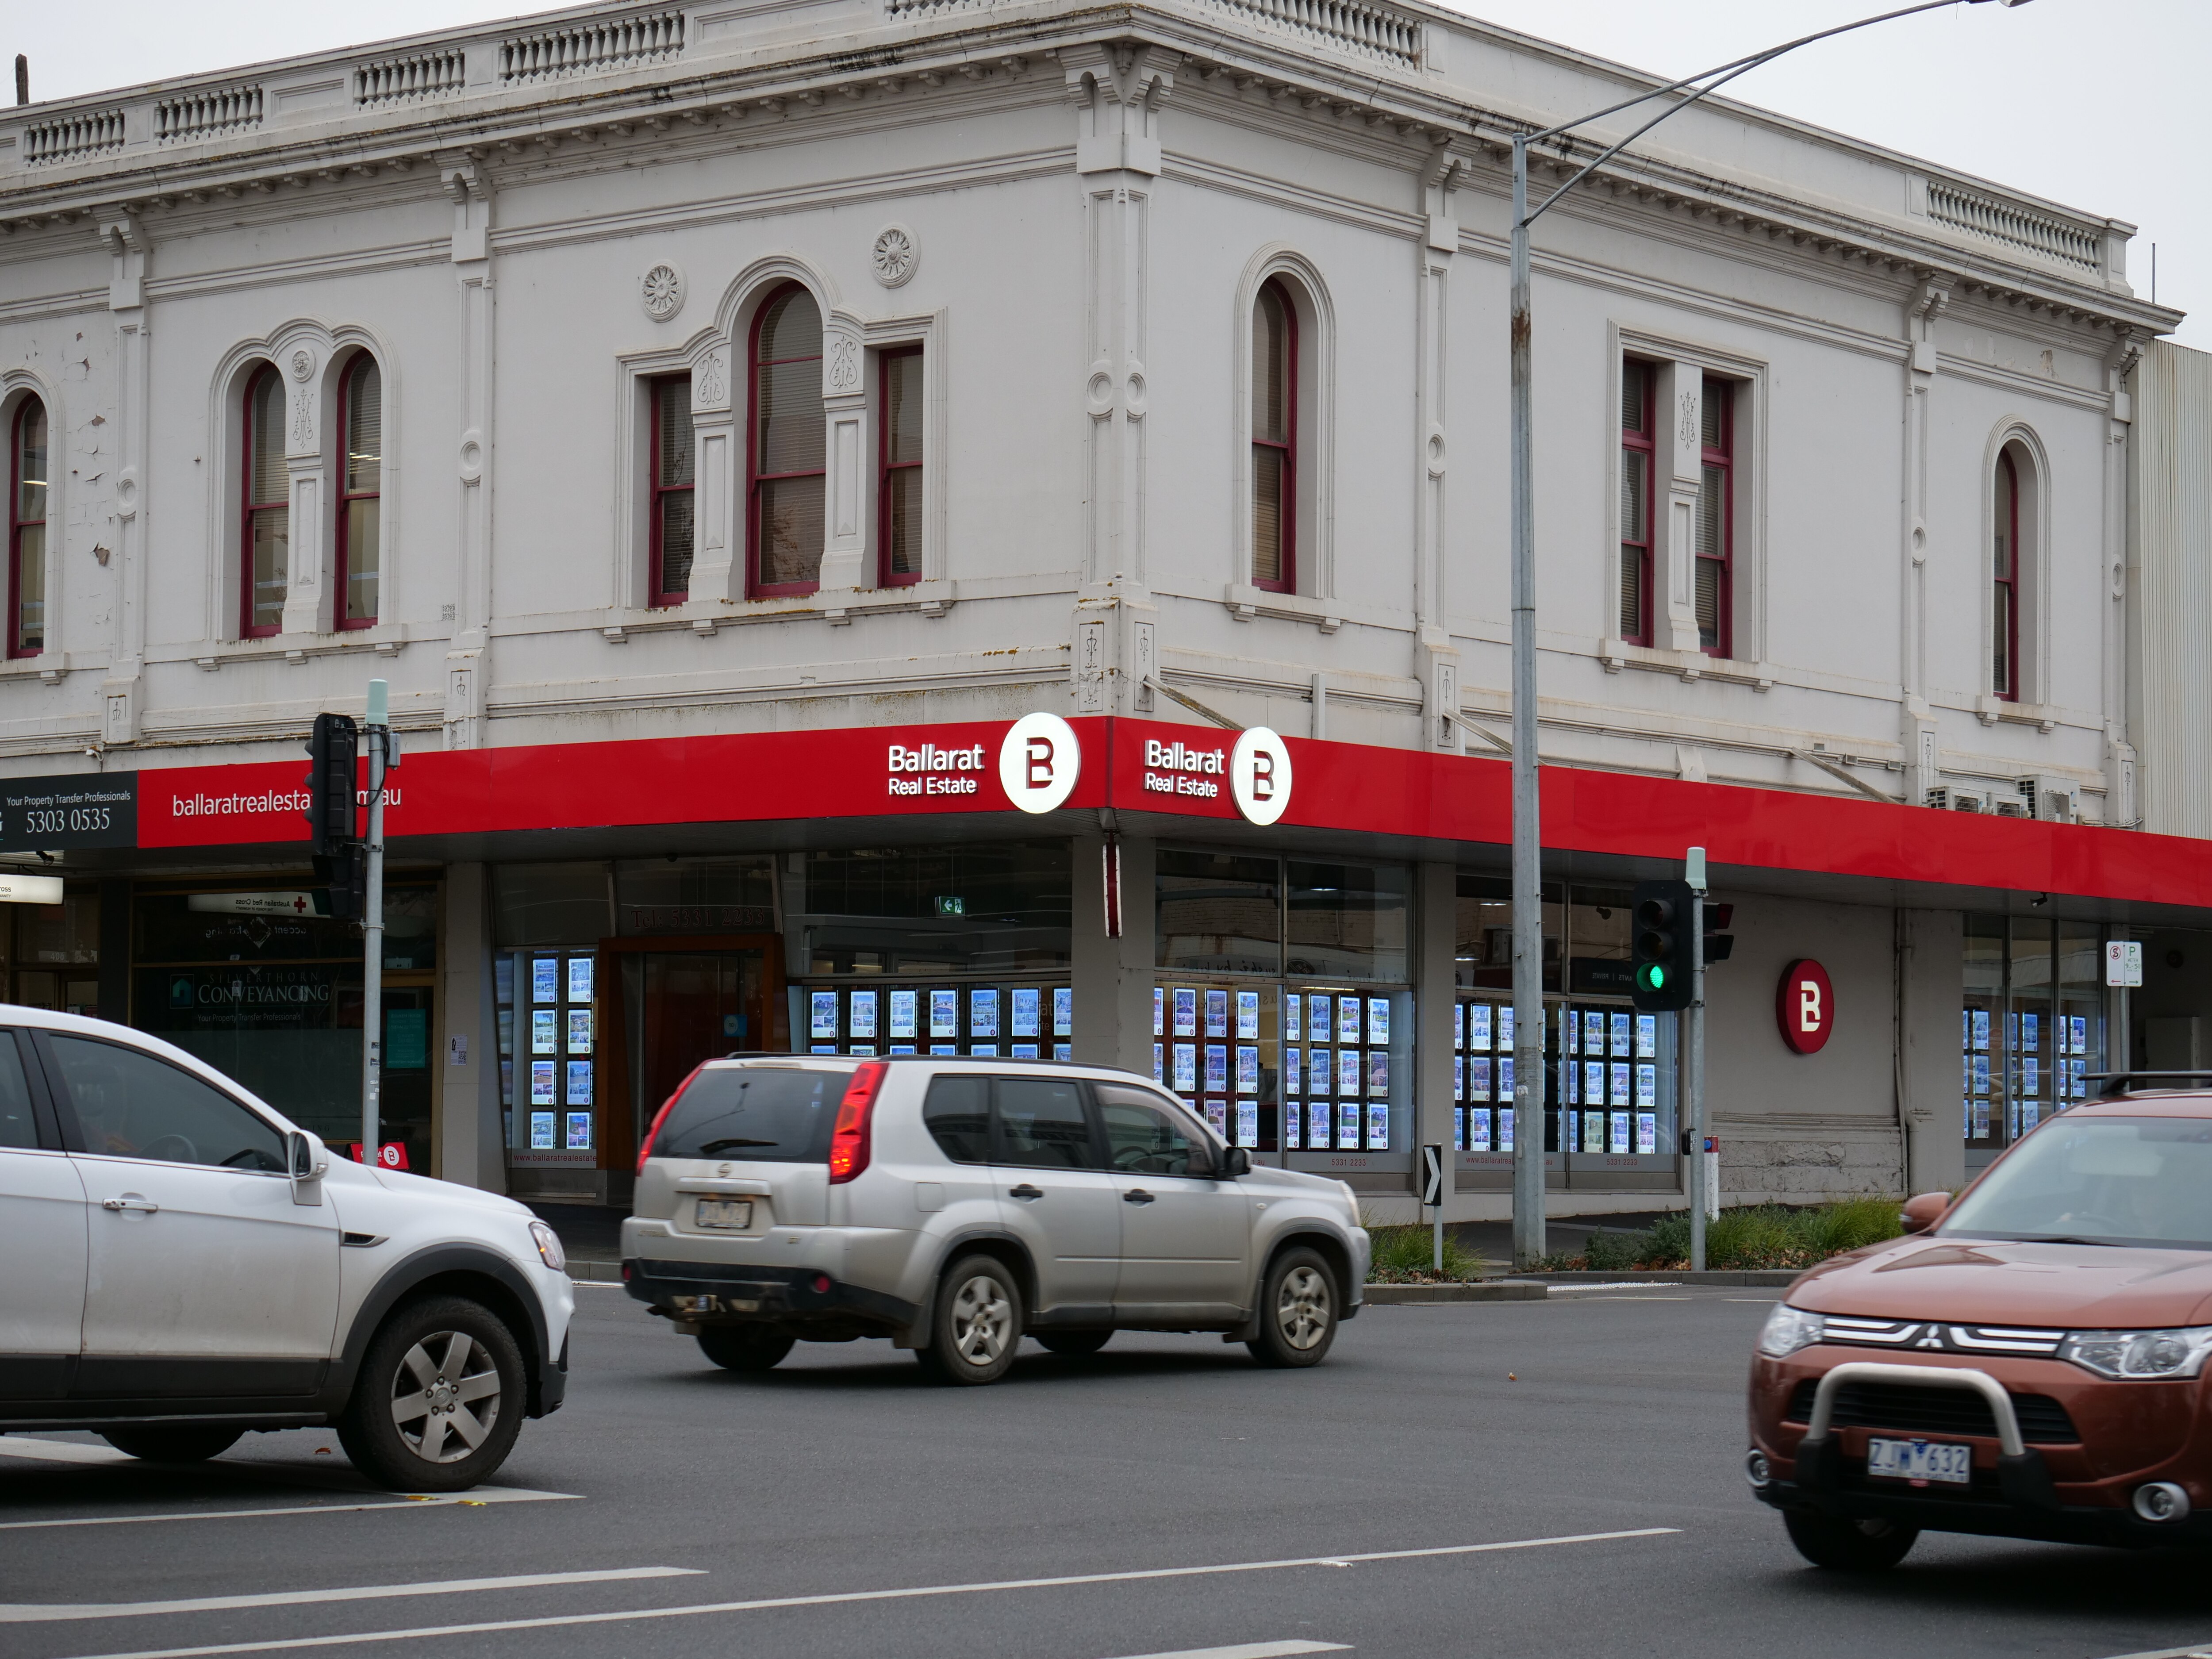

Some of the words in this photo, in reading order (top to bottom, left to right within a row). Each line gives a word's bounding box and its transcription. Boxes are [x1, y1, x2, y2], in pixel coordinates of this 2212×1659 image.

[889, 744, 985, 771] Ballarat
[1026, 737, 1054, 790] B
[1145, 740, 1224, 774] Ballarat
[889, 777, 922, 795] Real
[926, 776, 977, 795] Estate
[1146, 772, 1173, 792] Real
[1178, 776, 1218, 798] Estate
[1253, 750, 1275, 801] B
[7, 797, 23, 806] Your
[24, 796, 54, 807] Property
[55, 793, 83, 803] Transfer
[85, 791, 131, 802] Professionals
[27, 810, 65, 833] 5303
[71, 808, 110, 831] 0535
[631, 910, 663, 928] Tel:
[671, 909, 713, 927] 5331
[722, 907, 764, 926] 2233
[210, 972, 318, 984] SILVERTHORN
[198, 984, 329, 1003] CONVEYANCING
[1801, 980, 1821, 1032] B
[212, 1014, 237, 1023] Property
[238, 1013, 262, 1022] Transfer
[263, 1012, 301, 1021] Professionals
[1928, 1447, 1967, 1473] 632
